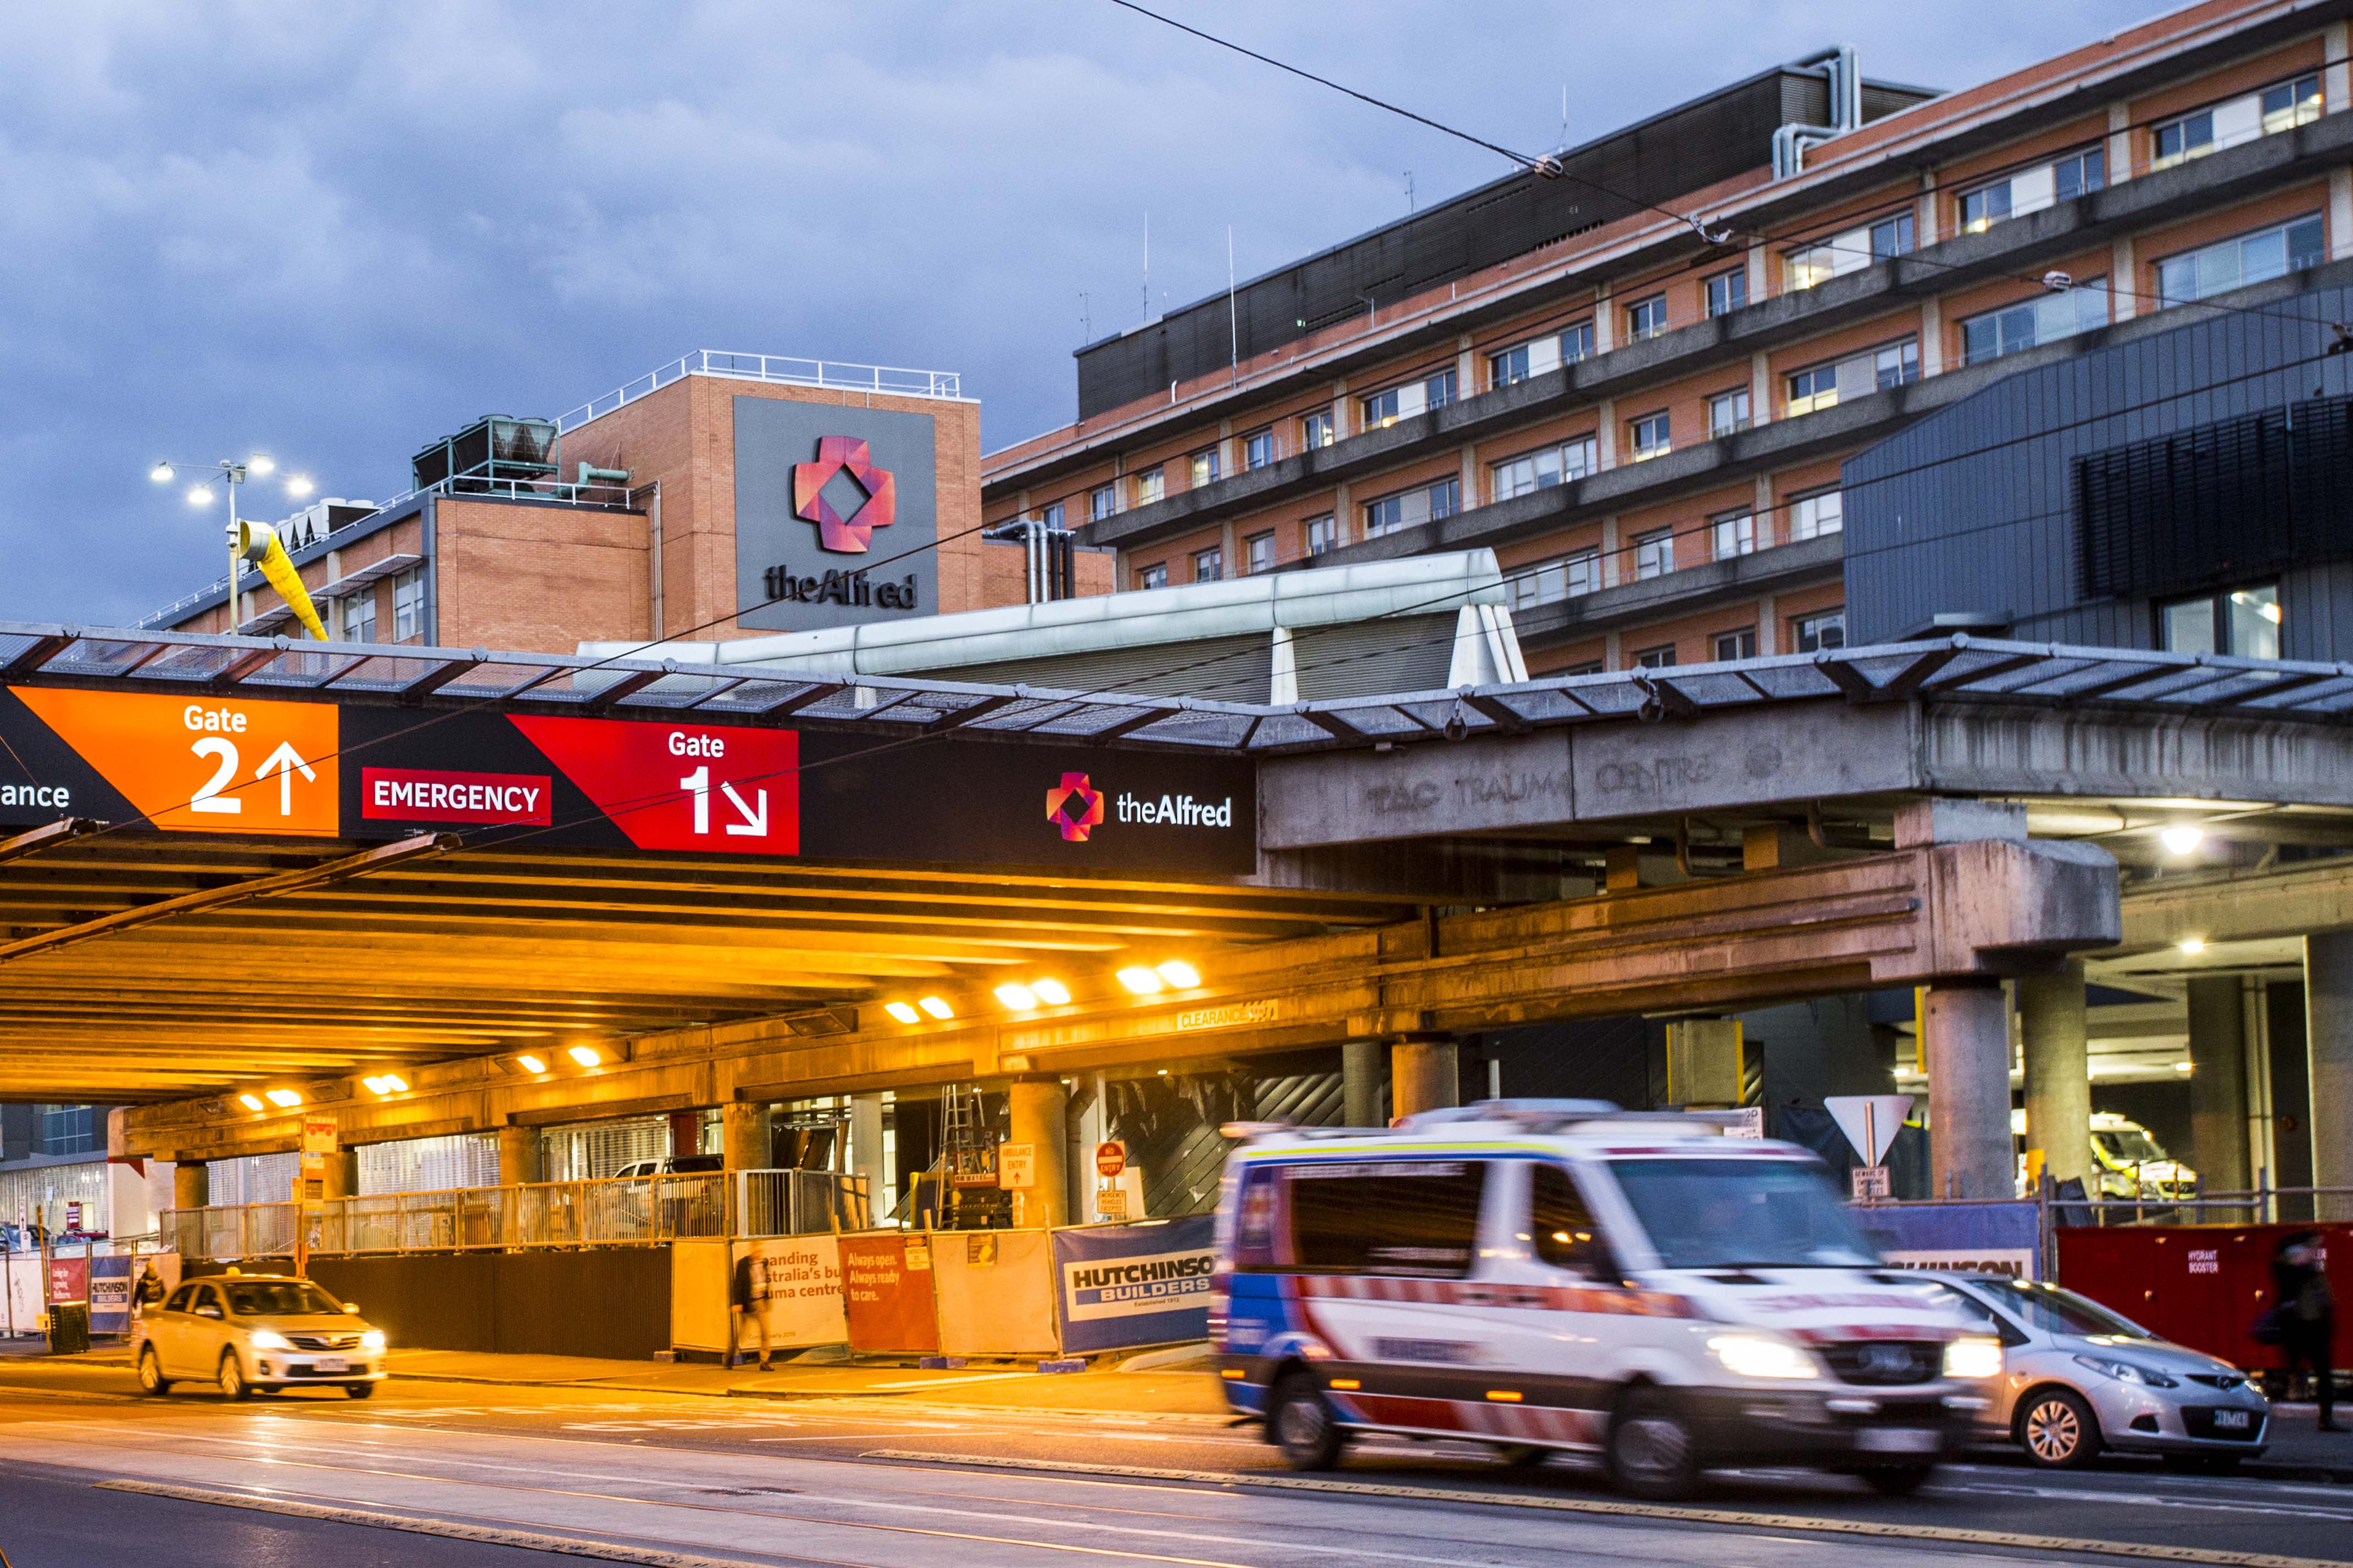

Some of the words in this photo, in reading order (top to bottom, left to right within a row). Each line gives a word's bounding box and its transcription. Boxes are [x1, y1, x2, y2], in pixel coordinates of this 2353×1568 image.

[183, 705, 247, 733] Gate
[669, 731, 725, 758] Gate
[190, 736, 242, 814] 2
[0, 784, 70, 808] ance
[374, 780, 539, 812] EMERGENCY
[680, 766, 709, 834] 1
[1116, 791, 1231, 828] theAlfred
[1182, 1007, 1248, 1028] CLEARANCE
[1002, 1146, 1032, 1157] AMBULANCE
[1105, 1147, 1115, 1156] NO
[1008, 1159, 1027, 1170] ENTRY
[1100, 1164, 1121, 1173] ENTRY
[764, 1251, 818, 1266] panding
[848, 1253, 875, 1269] Always
[876, 1253, 897, 1269] open.
[2188, 1249, 2218, 1262] HYDRANT
[766, 1267, 821, 1283] stralia's
[1072, 1255, 1216, 1288] HUTCHINSO
[2189, 1262, 2219, 1274] BOOSTER
[850, 1270, 876, 1286] Always
[877, 1269, 900, 1286] ready
[769, 1287, 796, 1299] uma
[851, 1288, 859, 1301] to
[860, 1291, 879, 1302] care.
[1100, 1277, 1210, 1302] BUILDERS
